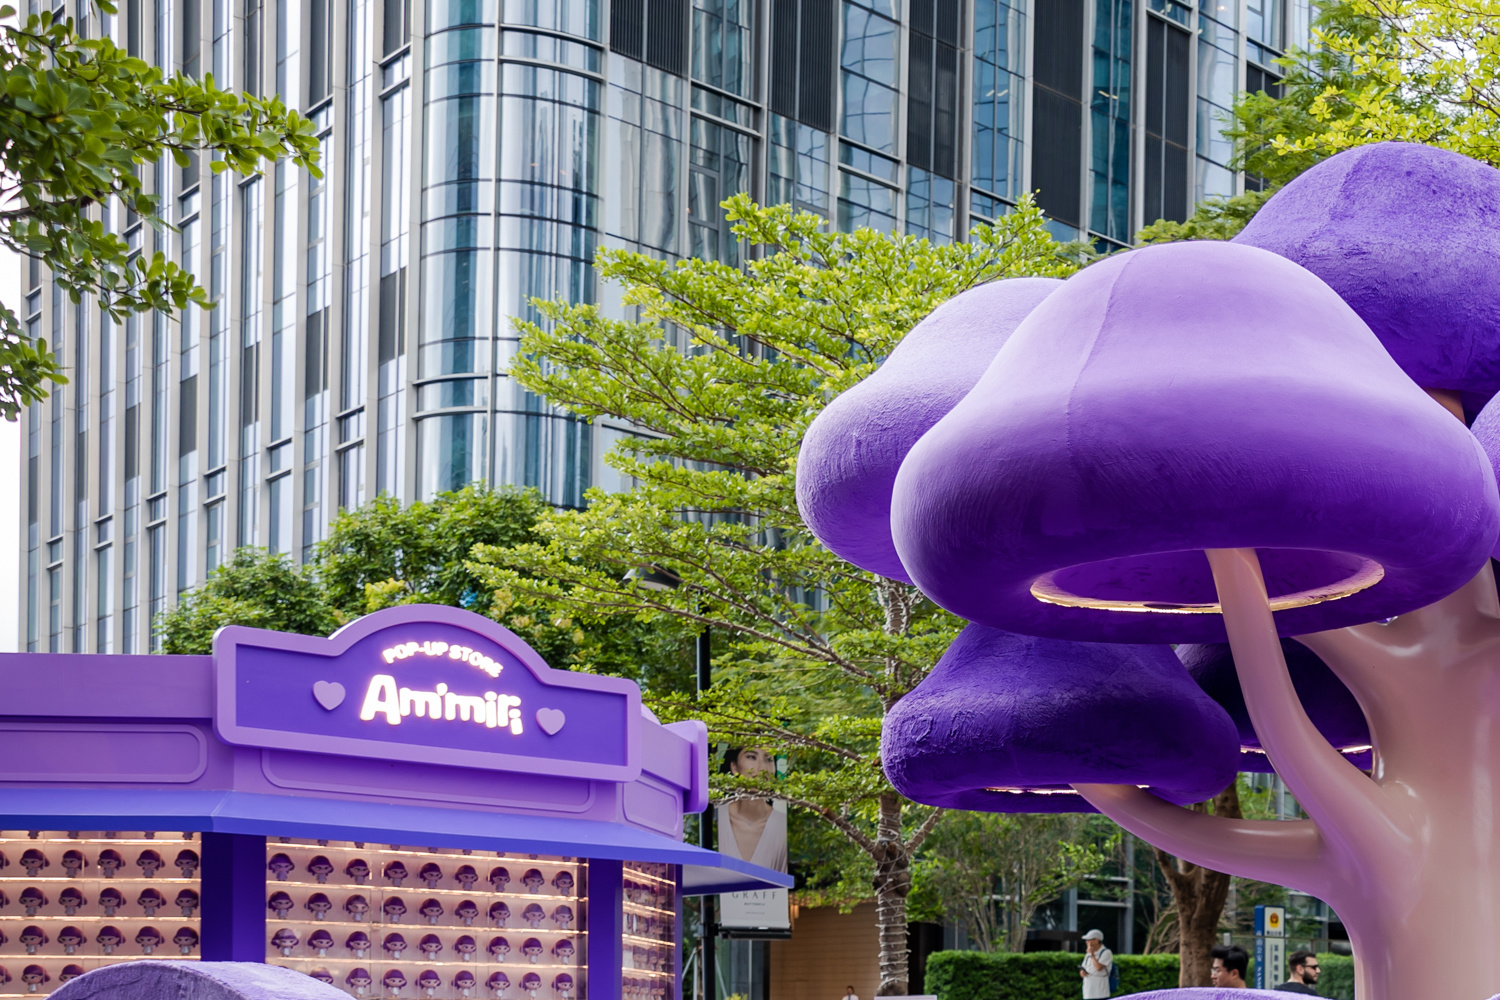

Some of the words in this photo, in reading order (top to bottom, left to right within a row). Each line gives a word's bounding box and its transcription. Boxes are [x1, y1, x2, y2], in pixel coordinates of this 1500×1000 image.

[382, 640, 449, 664] POP-UP
[449, 644, 504, 678] STORE
[731, 891, 776, 899] GRAFF
